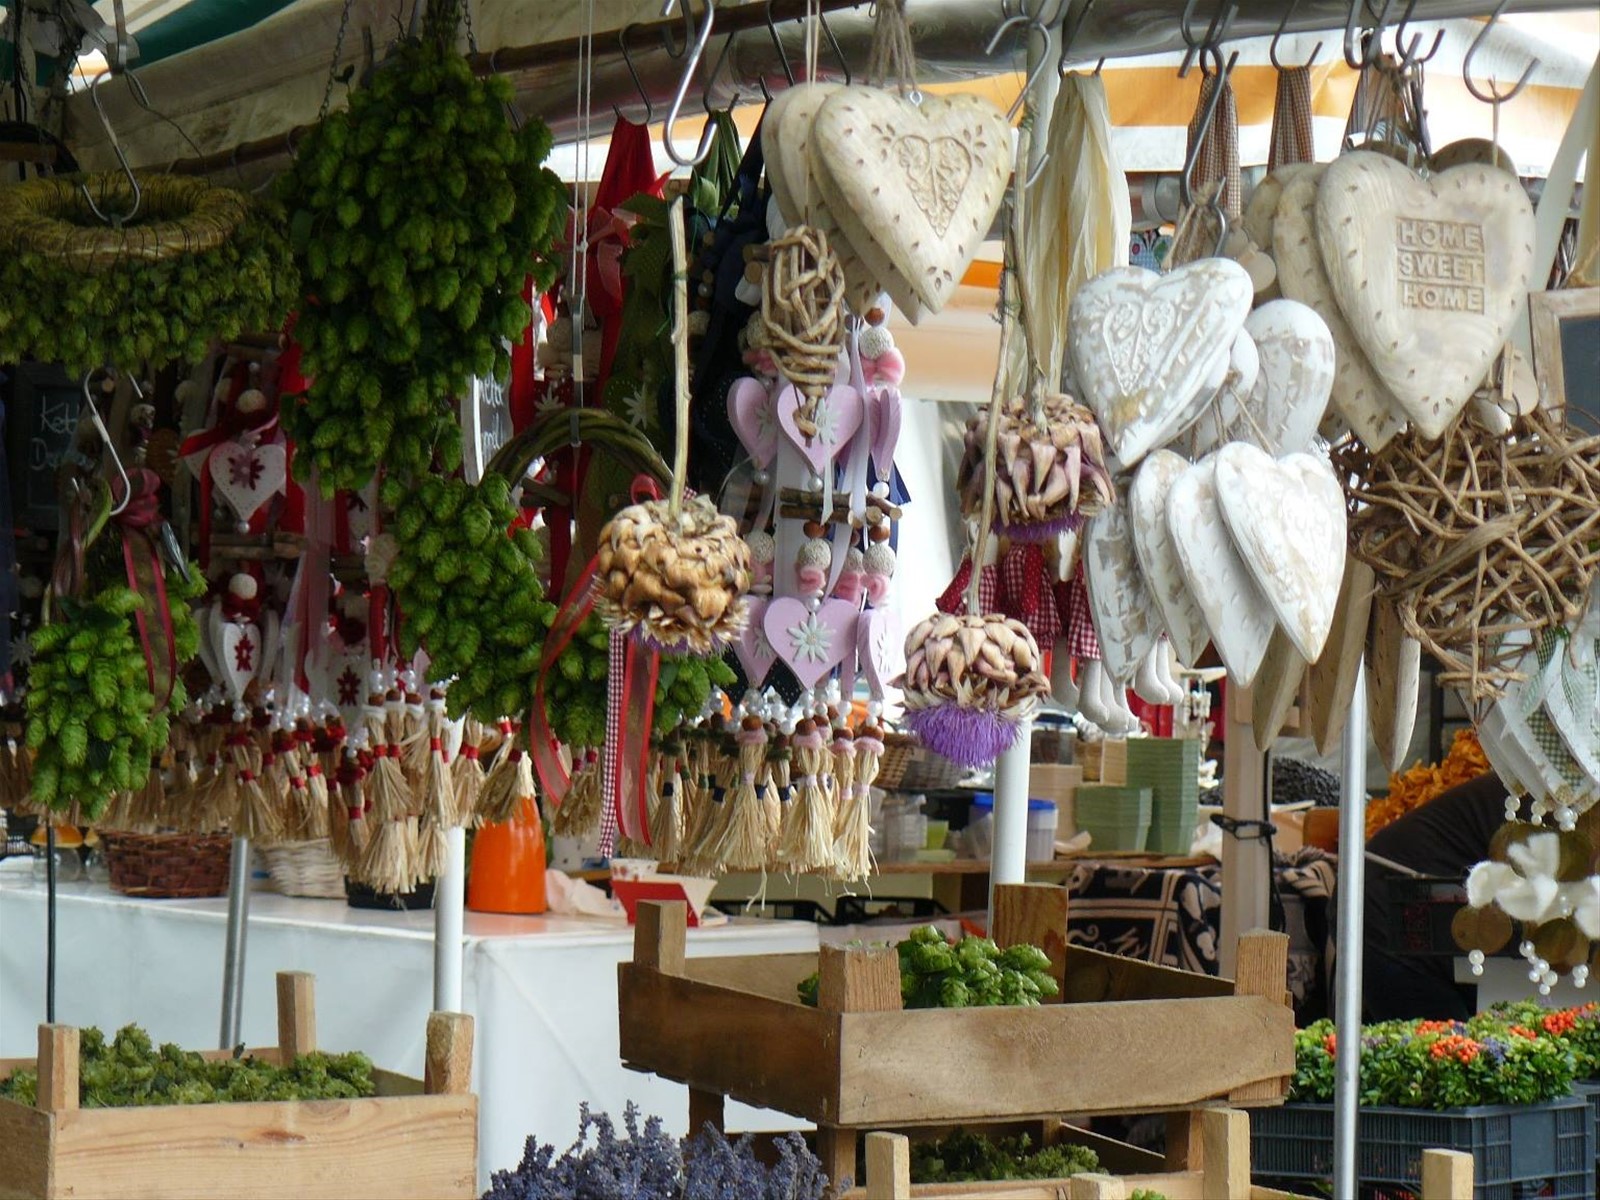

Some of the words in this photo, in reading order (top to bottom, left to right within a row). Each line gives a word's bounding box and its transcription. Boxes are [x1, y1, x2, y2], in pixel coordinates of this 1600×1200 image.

[1400, 220, 1481, 251] HOME
[1399, 252, 1484, 283] SWEET
[1402, 282, 1483, 312] HOME
